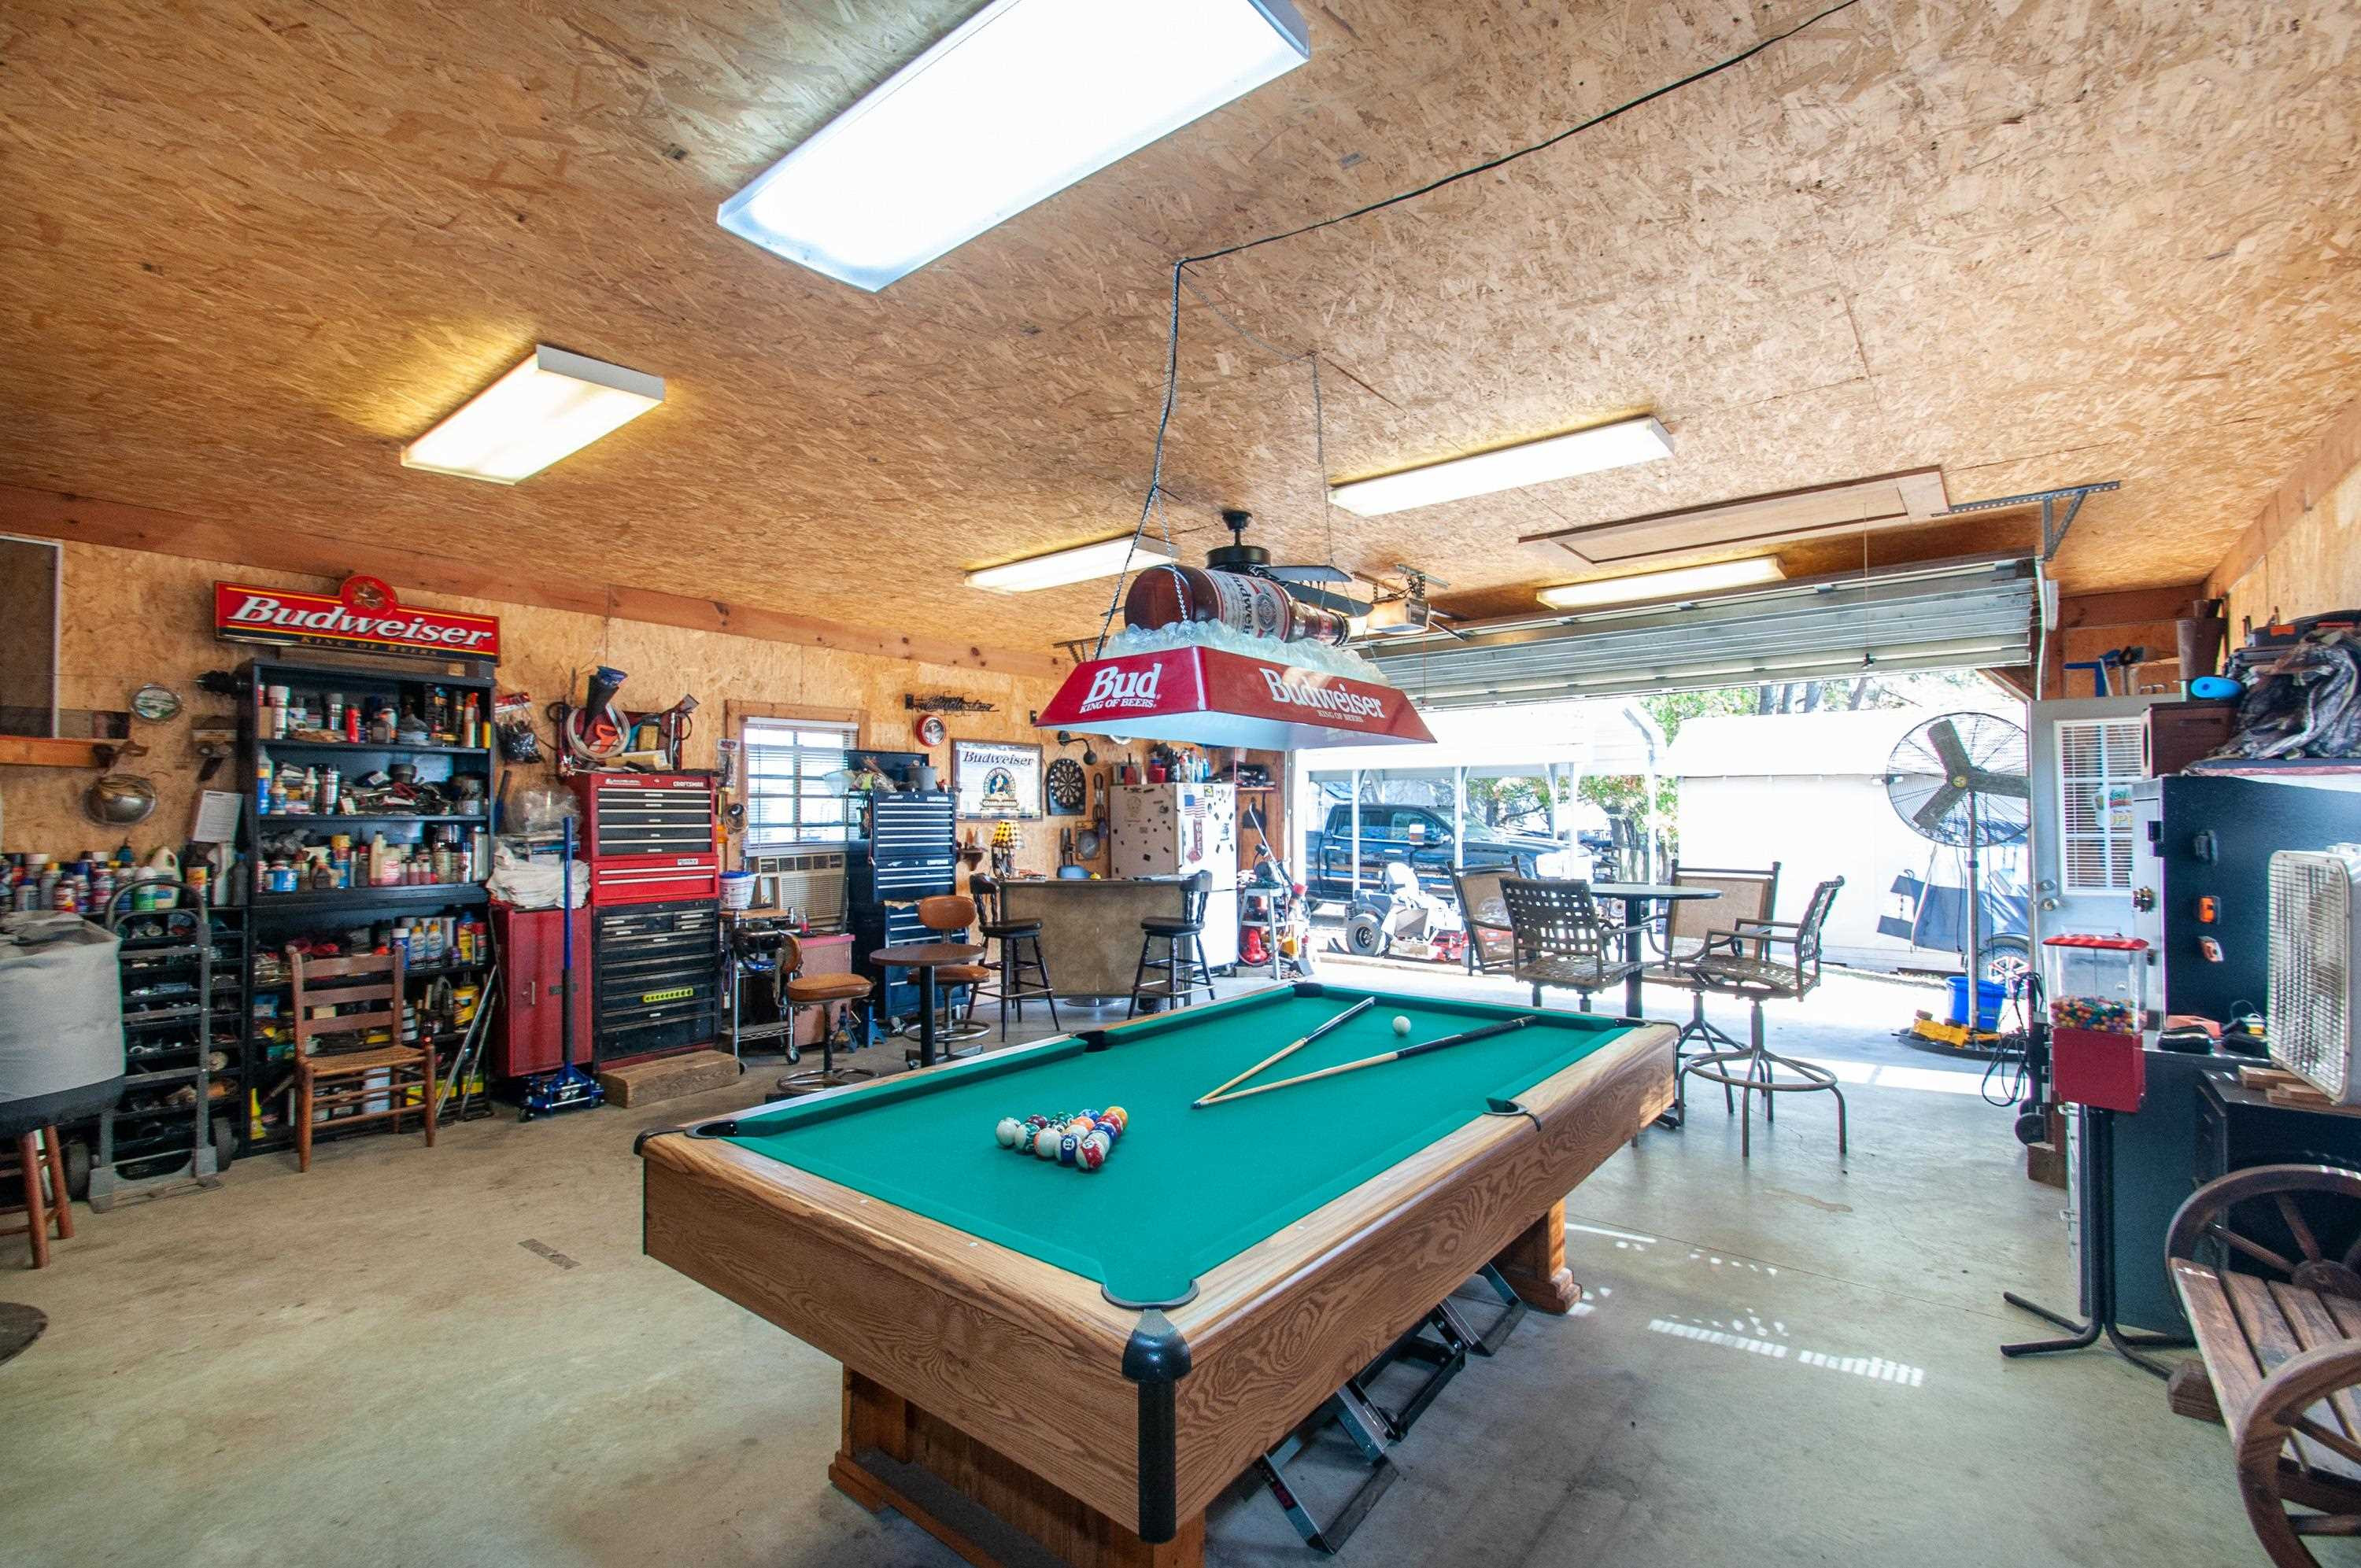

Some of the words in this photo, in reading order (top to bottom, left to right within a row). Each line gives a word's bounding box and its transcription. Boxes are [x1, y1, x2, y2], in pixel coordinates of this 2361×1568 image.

[227, 596, 493, 647] Budweiser
[1082, 662, 1162, 705] Bud
[1259, 667, 1385, 718] Budweiser
[1079, 700, 1104, 714] KING
[1105, 699, 1120, 708] OF
[1317, 710, 1334, 720] KING
[1334, 712, 1343, 721] OF
[1344, 714, 1365, 723] BEERS
[963, 751, 1034, 766] Budweiser
